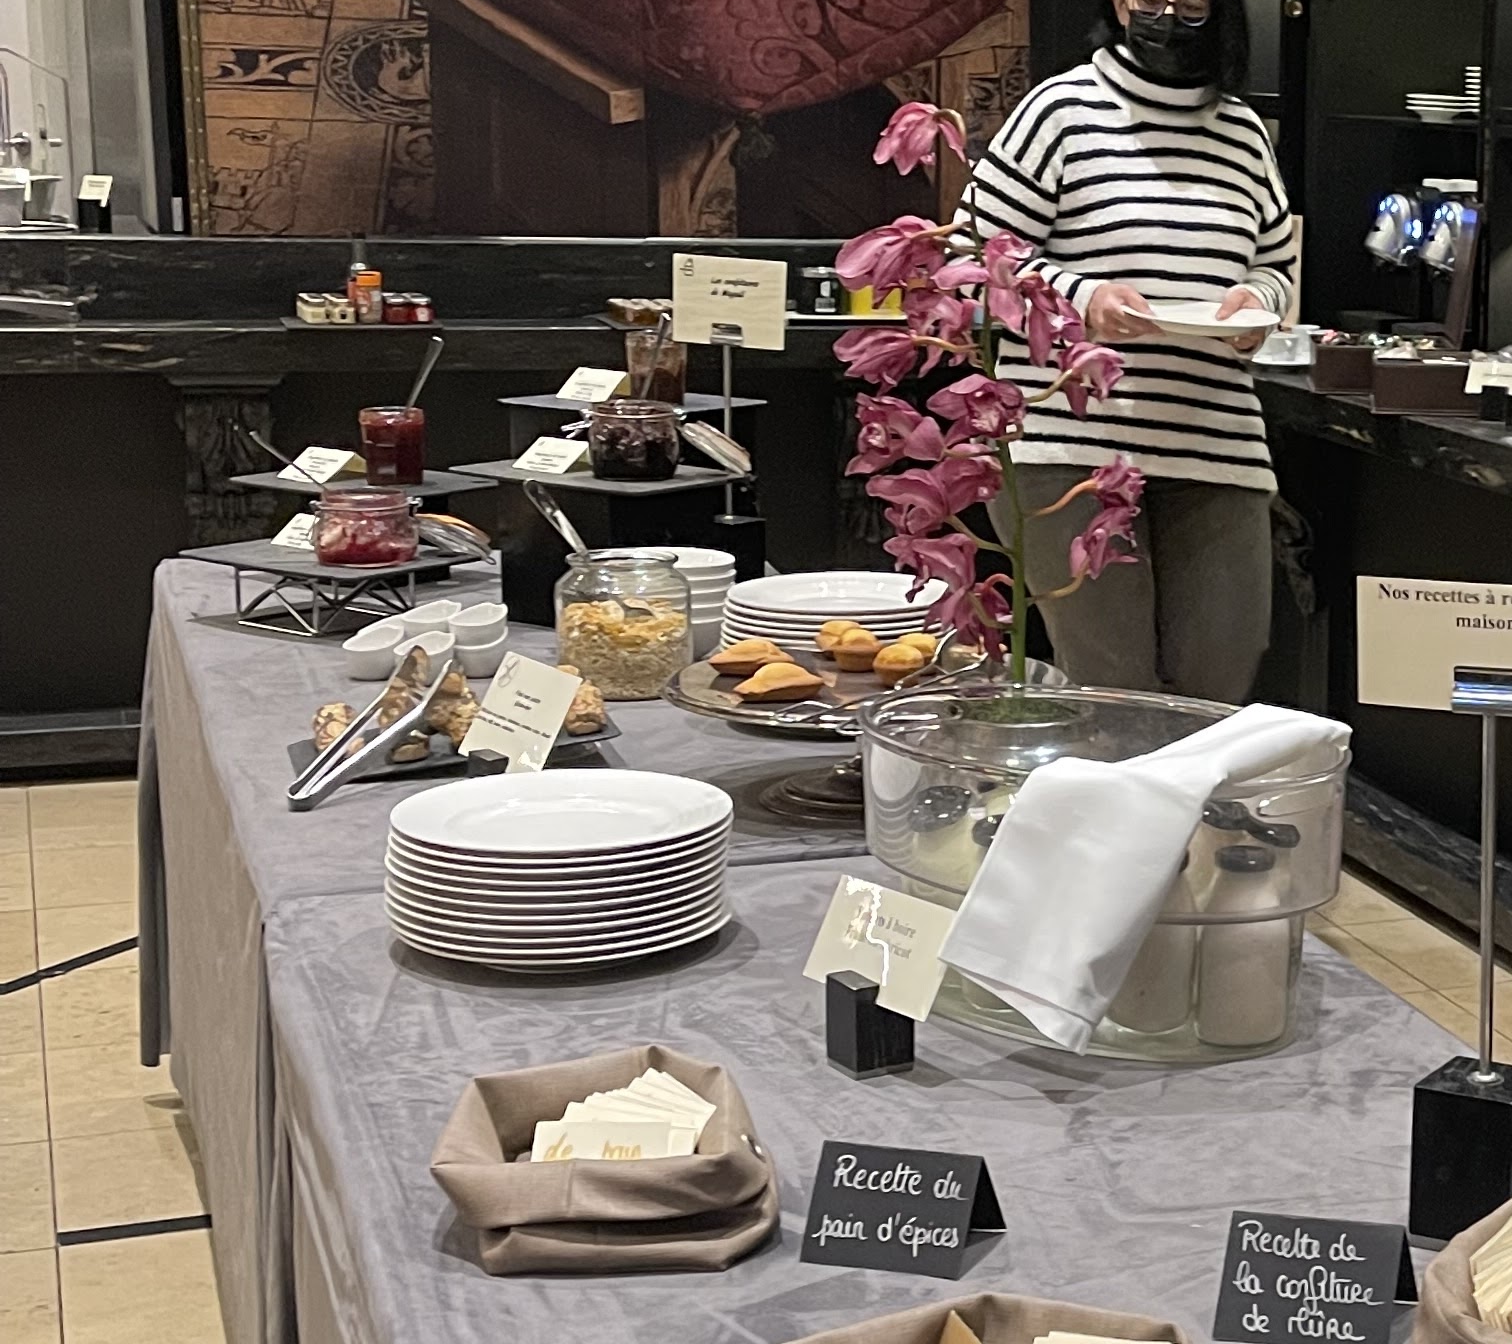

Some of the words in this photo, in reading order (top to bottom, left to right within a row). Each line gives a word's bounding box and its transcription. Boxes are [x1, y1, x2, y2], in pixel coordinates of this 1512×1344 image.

[1377, 582, 1410, 601] Nos
[1414, 587, 1481, 606] recettes
[1485, 588, 1496, 607] à
[832, 1154, 923, 1195] Recette
[933, 1170, 970, 1201] du
[811, 1213, 868, 1247] pain
[876, 1212, 960, 1258] d'épices
[1238, 1219, 1321, 1260] Recette
[1329, 1233, 1367, 1262] de
[1233, 1260, 1265, 1295] la
[1276, 1265, 1385, 1316] confiture
[1242, 1303, 1271, 1334] de
